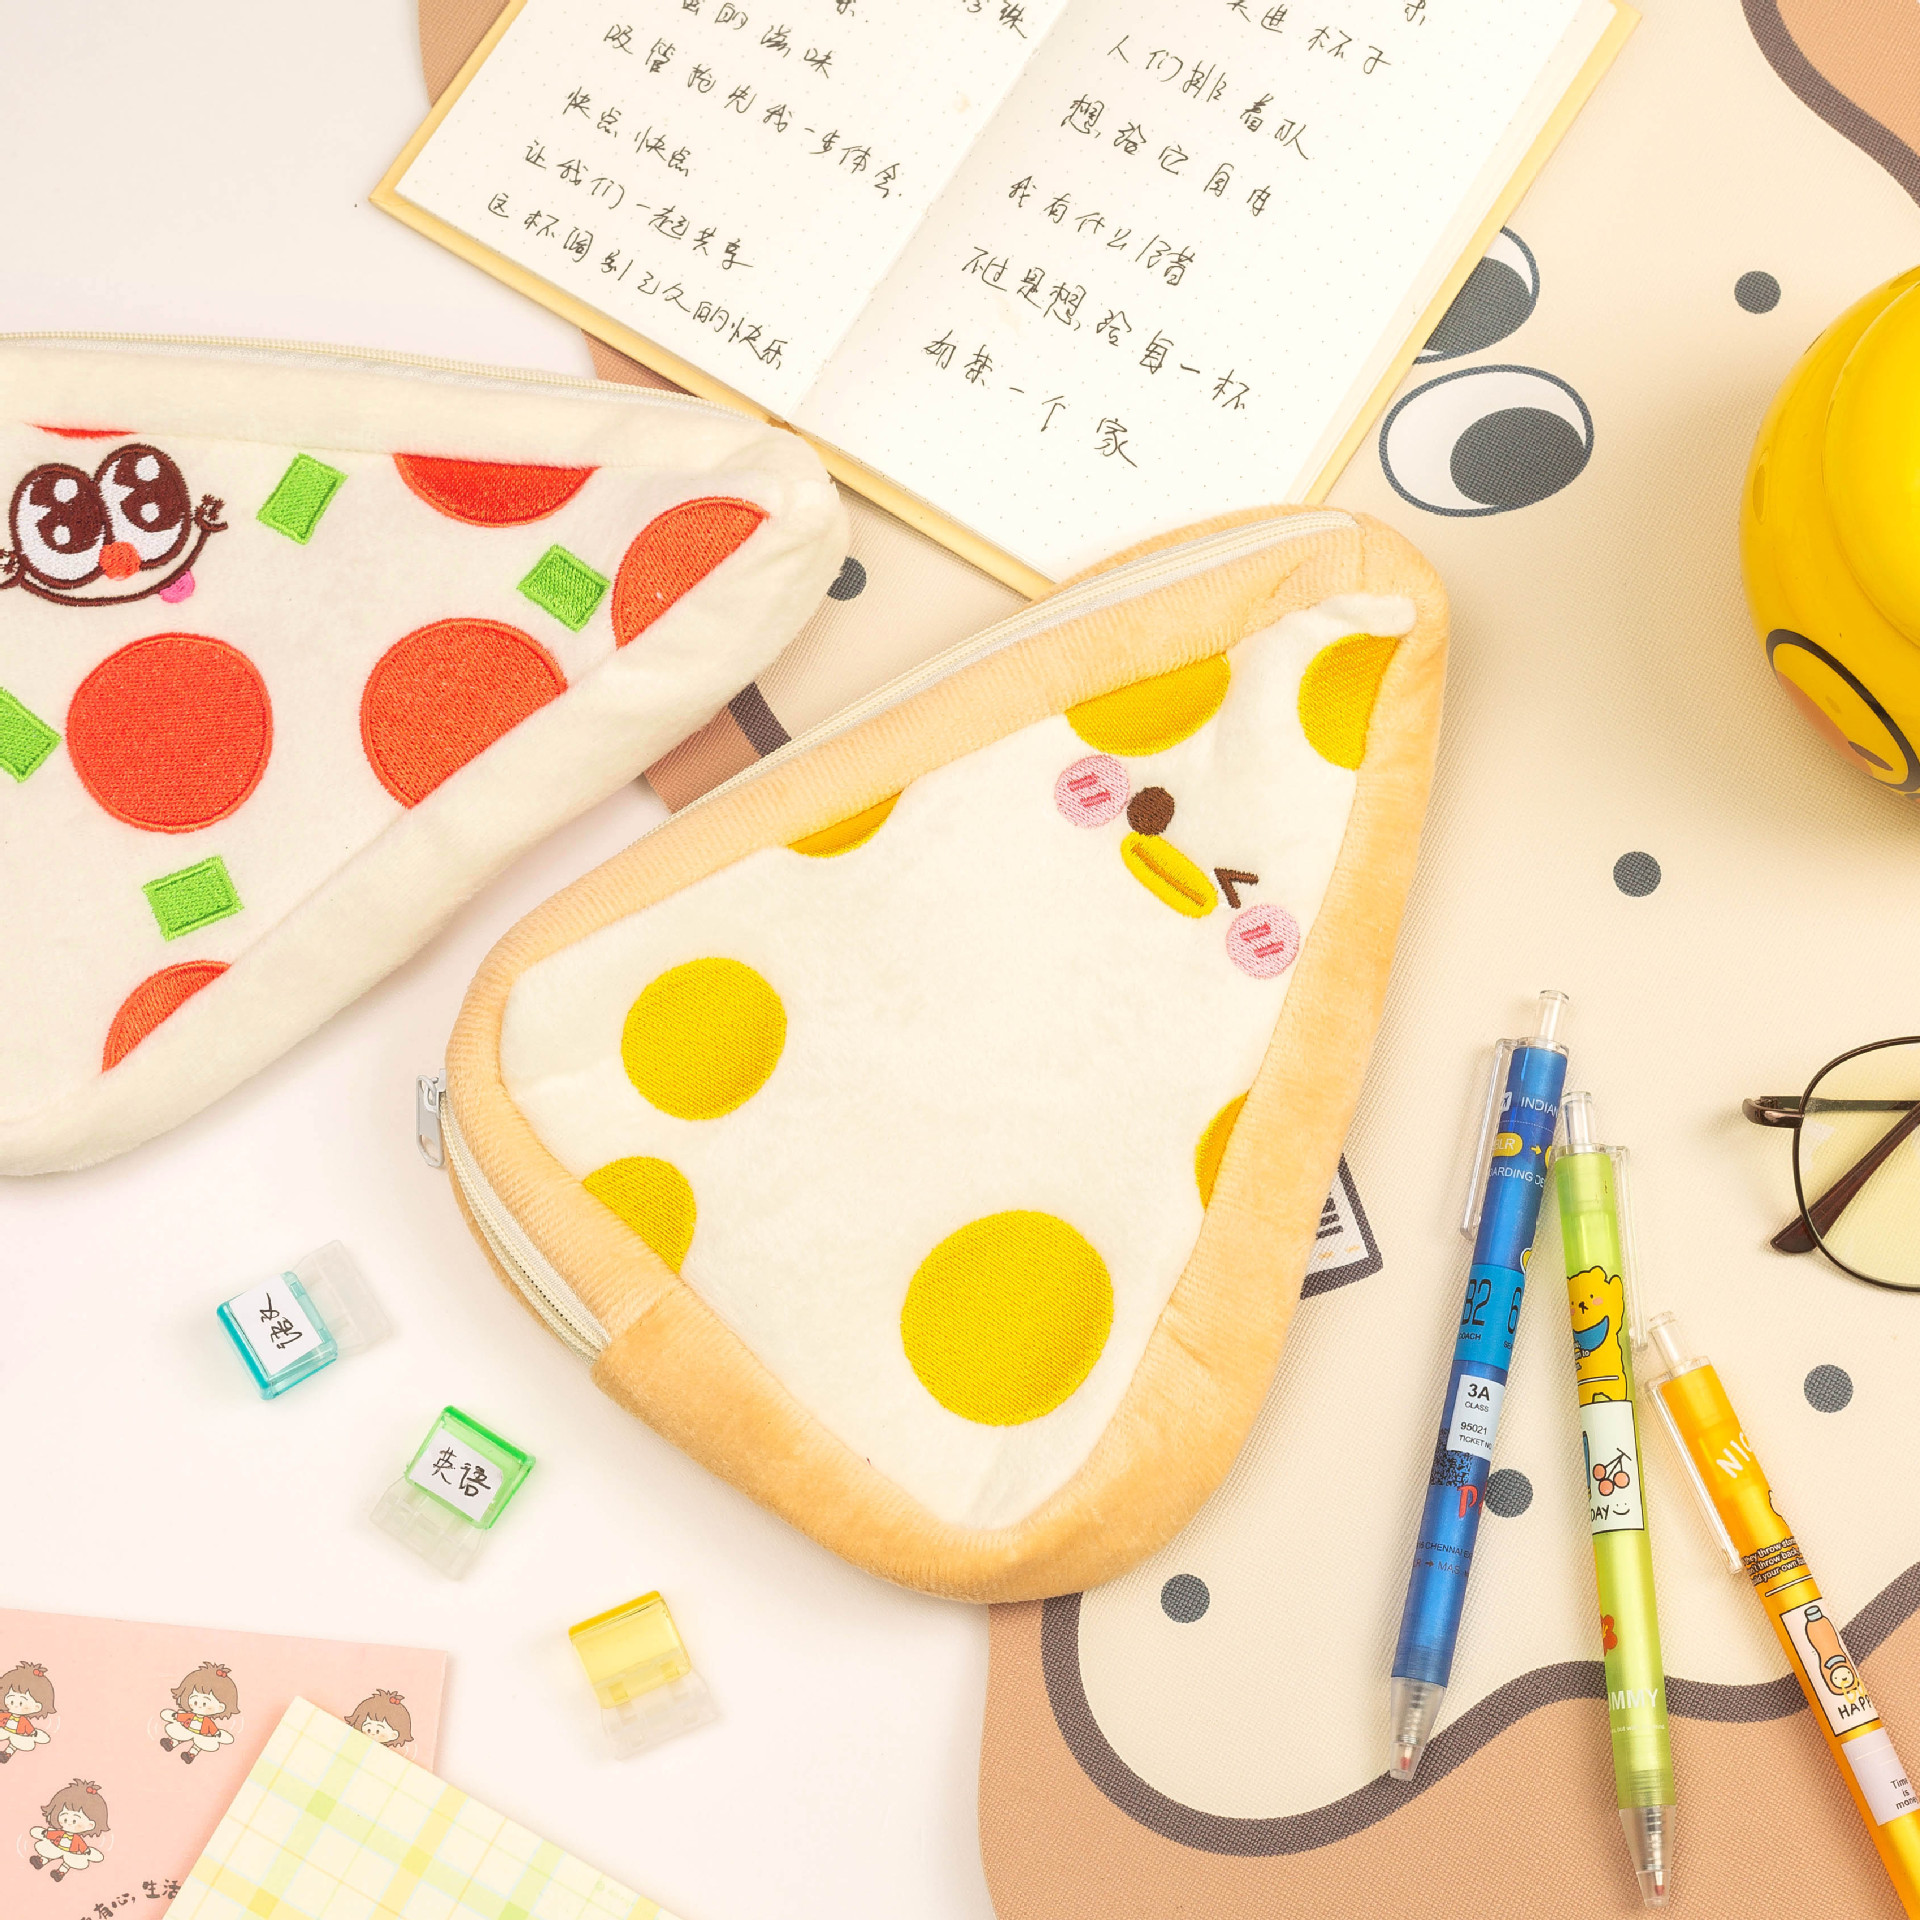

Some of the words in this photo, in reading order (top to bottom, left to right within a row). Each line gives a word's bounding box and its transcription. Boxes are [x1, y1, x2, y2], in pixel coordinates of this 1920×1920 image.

[1467, 1383, 1491, 1402] 3A
[1464, 1401, 1490, 1413] CLASS
[1460, 1421, 1488, 1436] 95021
[1459, 1434, 1486, 1447] TICKET
[431, 1446, 492, 1498] 英语
[1757, 1544, 1782, 1560] throw
[1436, 1560, 1461, 1575] MAS
[1757, 1555, 1781, 1571] throw
[1761, 1566, 1781, 1583] your
[1780, 1559, 1798, 1572] own
